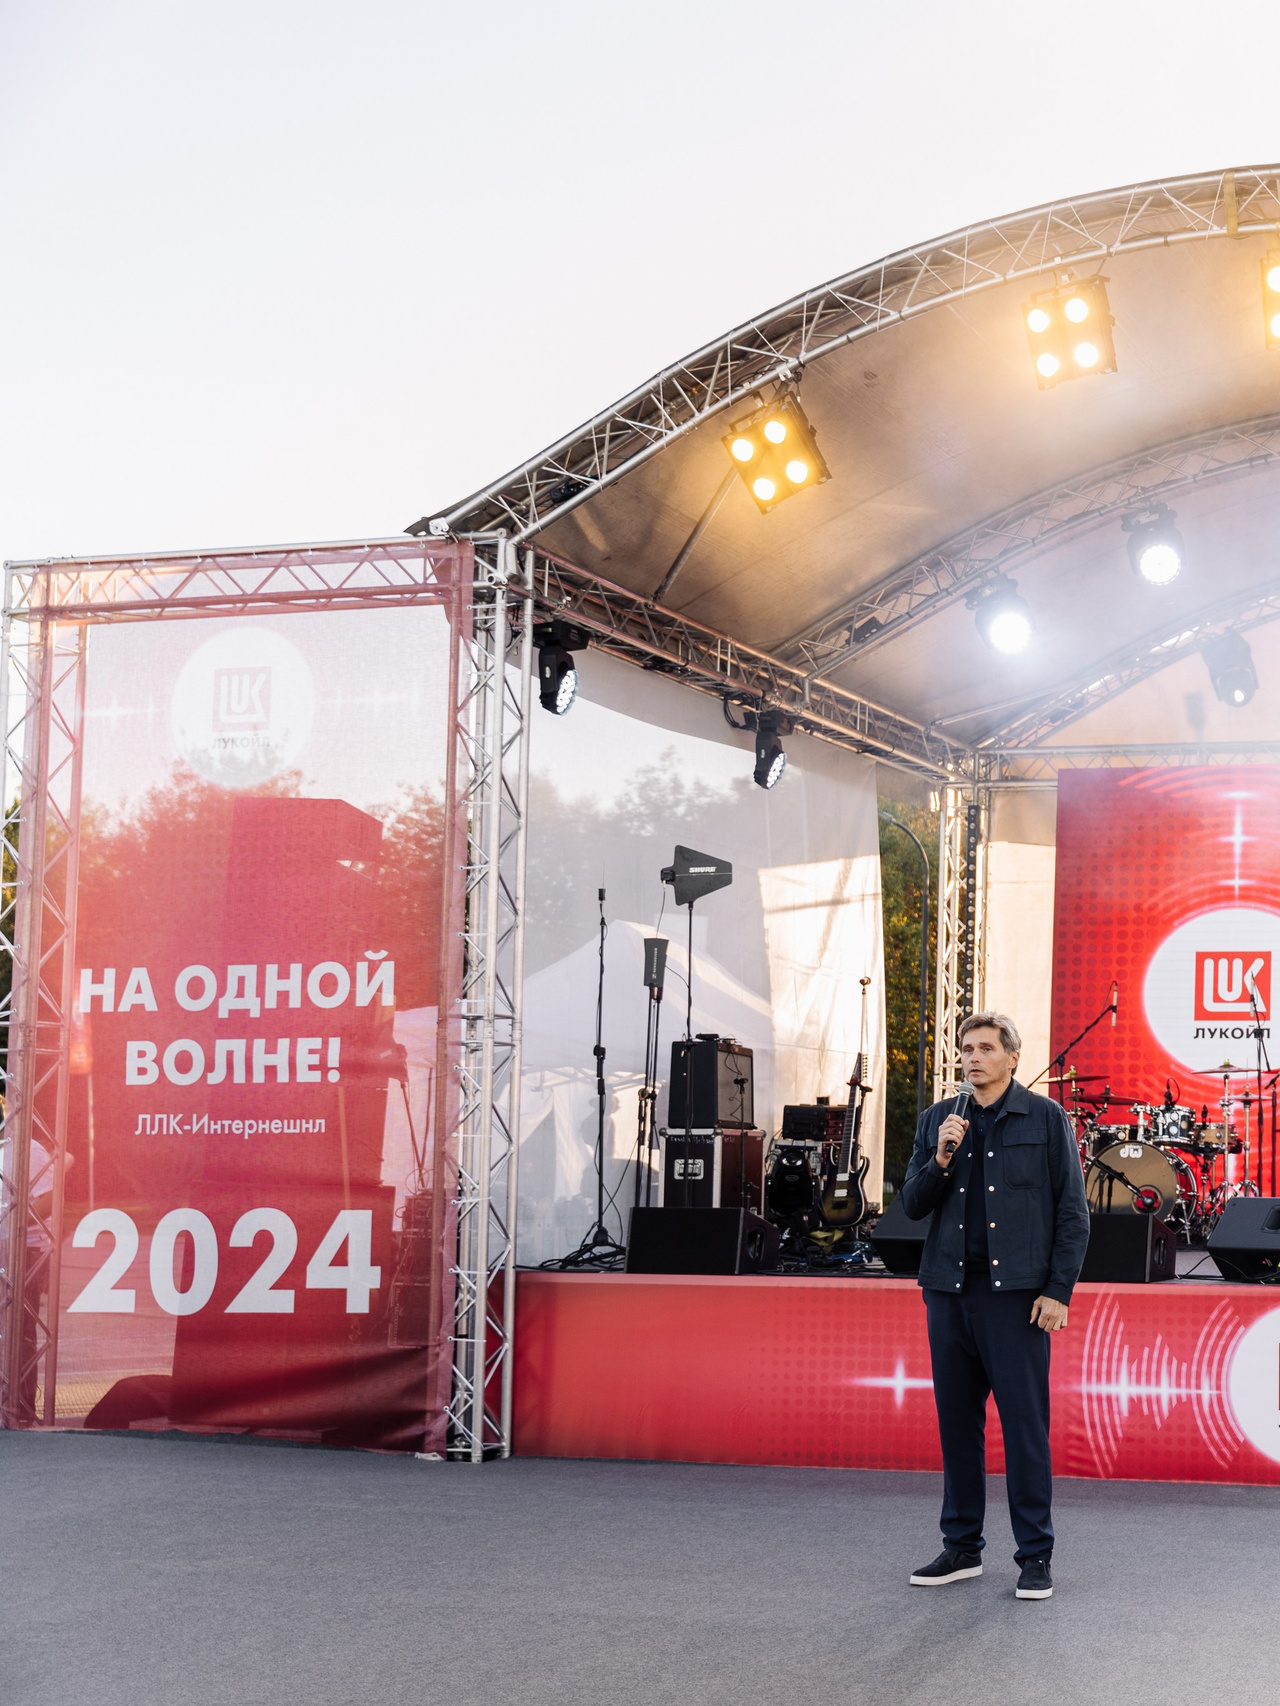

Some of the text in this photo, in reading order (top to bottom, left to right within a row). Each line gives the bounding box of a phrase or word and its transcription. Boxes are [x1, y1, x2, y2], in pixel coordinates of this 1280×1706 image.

[212, 732, 271, 750] ЛУКОЙЛ
[80, 950, 395, 1018] НА ОДНОЙ
[1203, 958, 1267, 1012] LUK
[125, 1037, 341, 1086] ВОЛНЕ!
[134, 1113, 326, 1140] ЛЛК-Интернешнл
[67, 1207, 381, 1315] 2024
